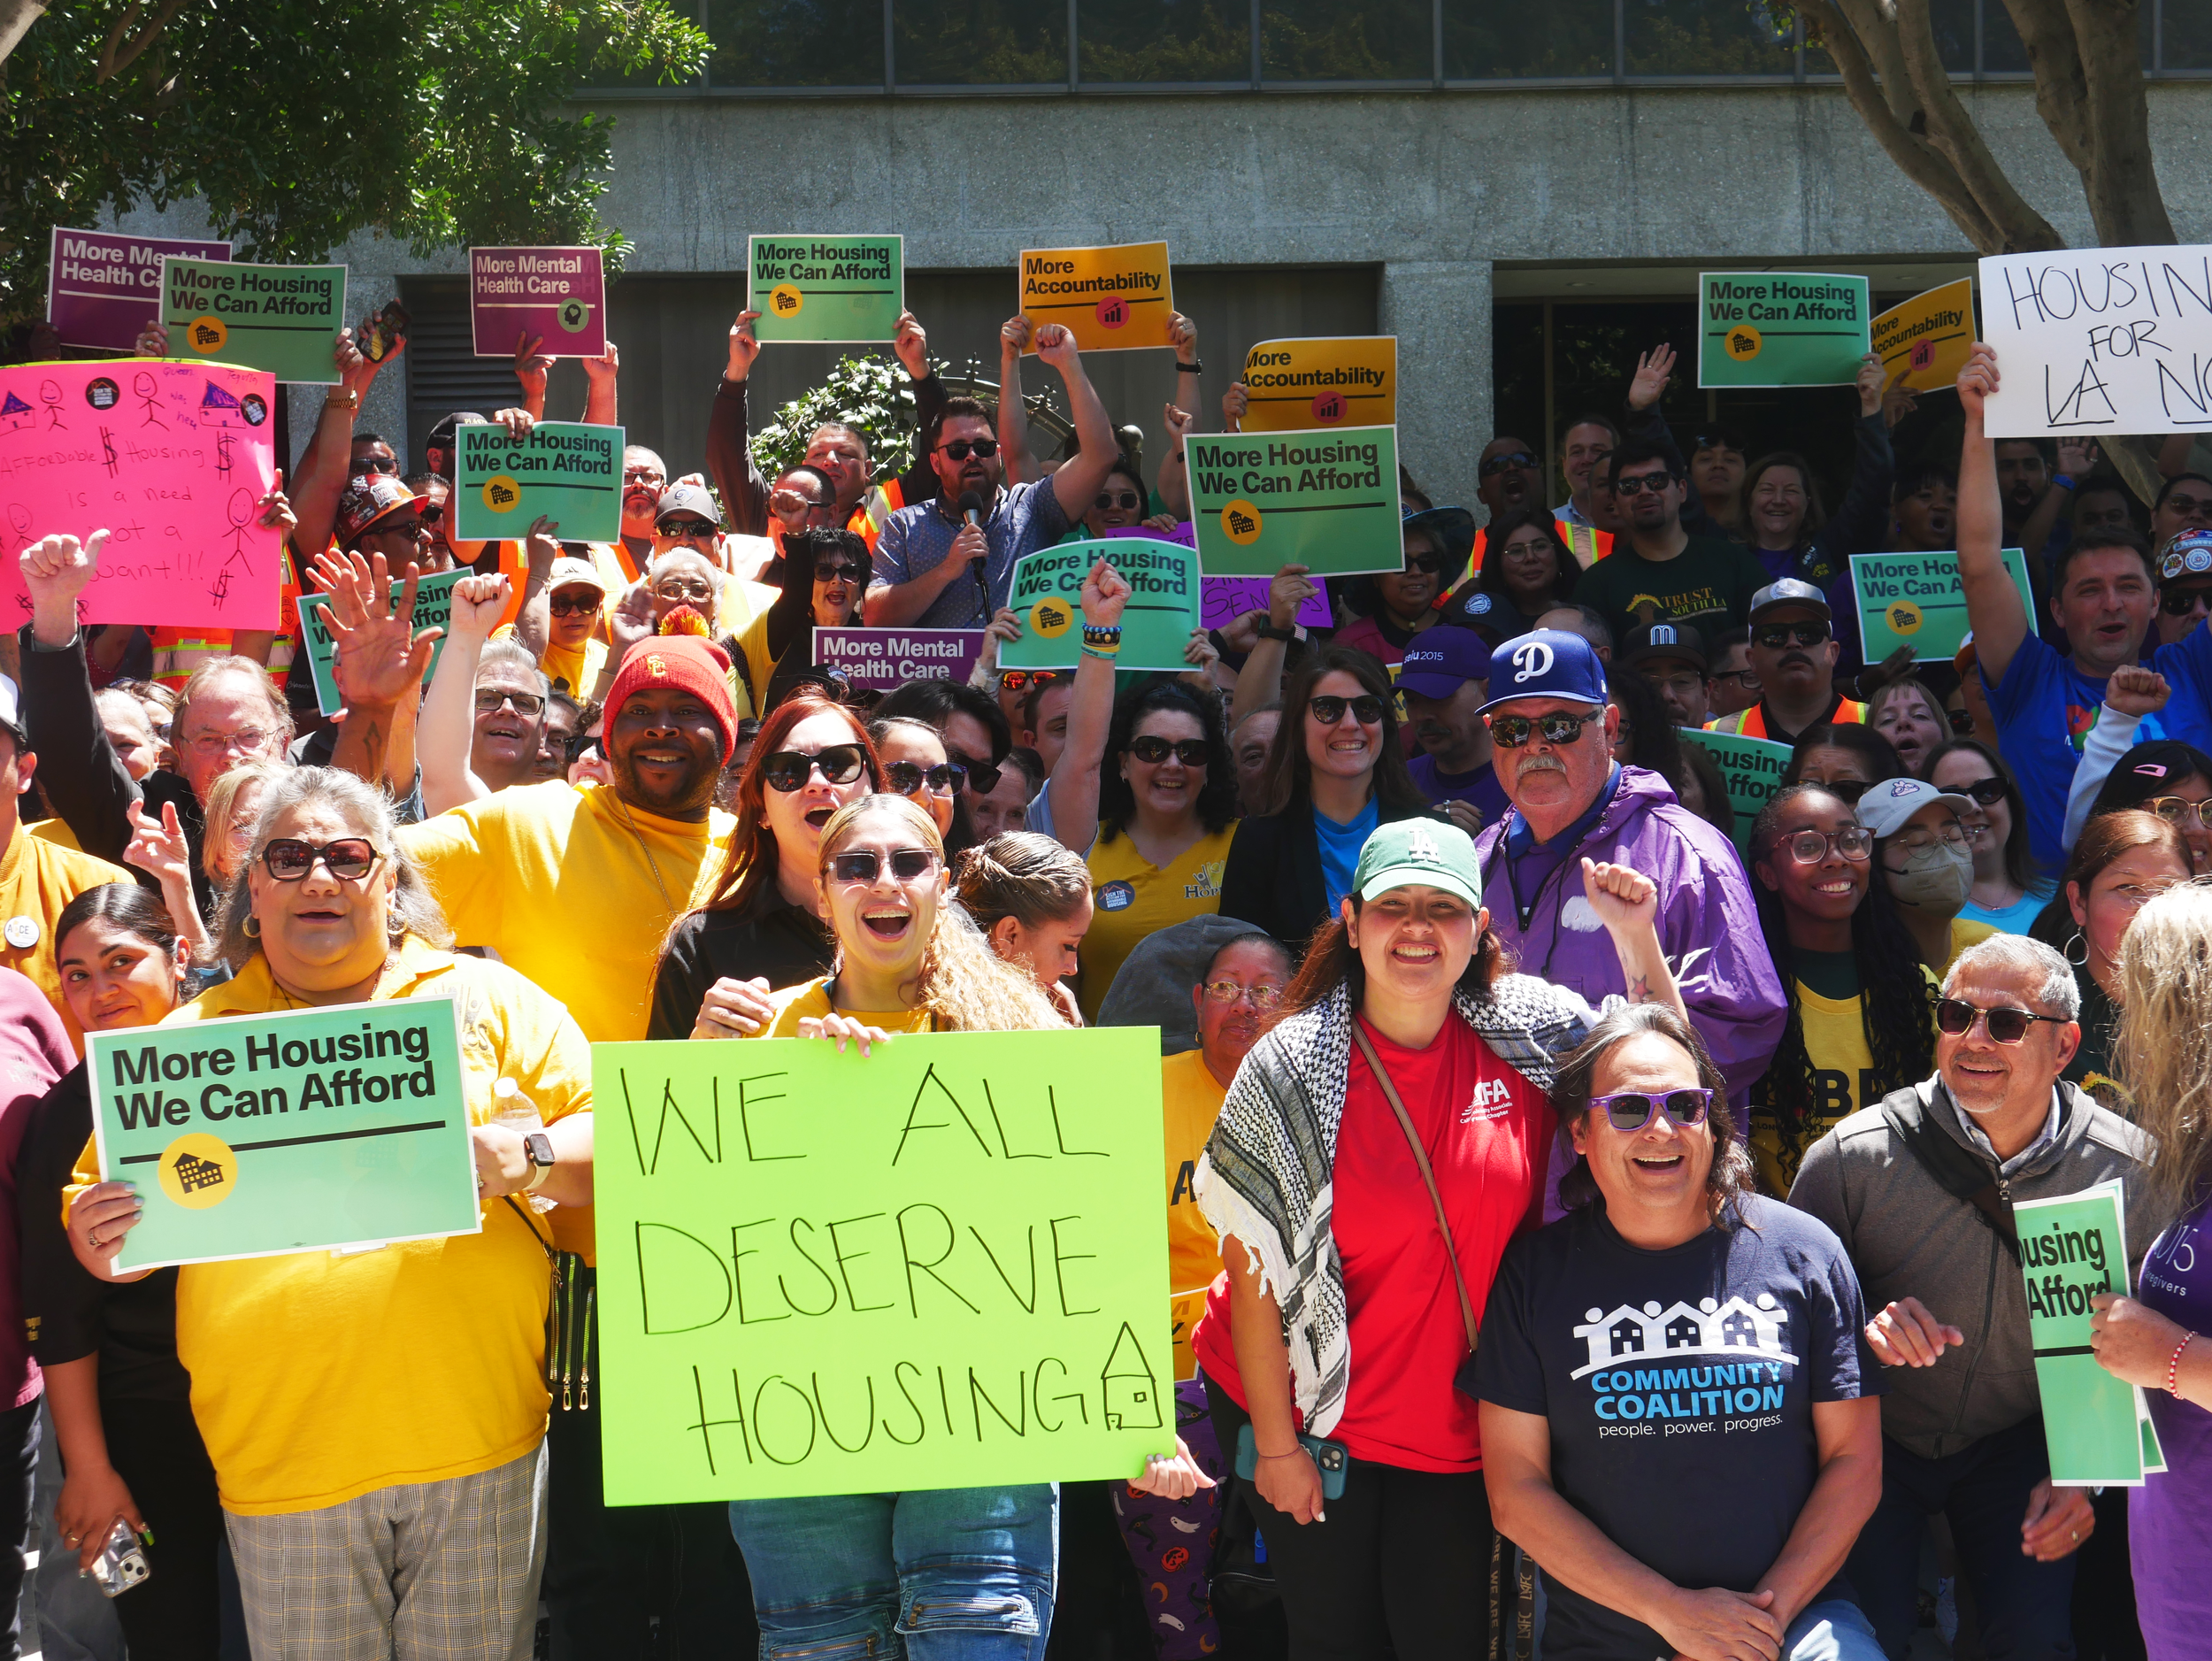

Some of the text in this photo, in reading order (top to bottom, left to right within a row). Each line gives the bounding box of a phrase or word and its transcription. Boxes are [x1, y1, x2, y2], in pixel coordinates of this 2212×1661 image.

[63, 238, 124, 263] More
[757, 242, 890, 265] More Housing
[61, 260, 134, 286] Health
[476, 255, 581, 274] More Mental
[757, 263, 891, 281] We Can Afford
[1025, 258, 1074, 276] More
[173, 267, 332, 297] More Housing
[476, 275, 570, 294] Health Care
[1025, 272, 1162, 295] Accountability
[1709, 281, 1855, 305] More Housing
[171, 289, 332, 315] We Can Afford
[1708, 302, 1856, 321] We Can Afford
[1870, 317, 1899, 342] More
[1871, 310, 1963, 355] Accountability
[2087, 319, 2172, 362] FOR
[1244, 351, 1292, 370] More
[1240, 366, 1385, 388] Accountability
[2045, 358, 2117, 424] LA
[125, 439, 204, 468] Housing
[466, 431, 612, 458] More Housing
[1196, 440, 1378, 468] More Housing
[465, 452, 612, 475] We Can Afford
[1198, 465, 1380, 495] We Can Afford
[113, 489, 127, 503] a
[143, 486, 193, 502] need
[164, 526, 182, 541] a
[1021, 549, 1186, 580] More Housing
[1861, 561, 1919, 579] More
[1018, 576, 1052, 597] We
[1863, 581, 1900, 598] We
[1903, 579, 1946, 596] Can
[1671, 599, 1709, 617] SOUTH
[1713, 597, 1727, 607] LA
[823, 636, 964, 657] More Mental
[1403, 650, 1444, 664] seiu 2015
[898, 659, 950, 680] Care
[1512, 642, 1555, 683] D
[1700, 742, 1790, 779] ousing
[111, 1046, 235, 1087] More
[246, 1022, 430, 1070] Housing
[114, 1061, 435, 1131] We Can Afford
[620, 1062, 1110, 1175] WE ALL
[634, 1203, 1101, 1335] DESERVE
[1591, 1361, 1783, 1393] COMMUNITY
[1594, 1384, 1784, 1420] COALITION
[687, 1357, 1088, 1476] HOUSING
[1599, 1414, 1783, 1439] people. power. progress.
[1489, 1534, 1502, 1661] ARE WE ARE WE
